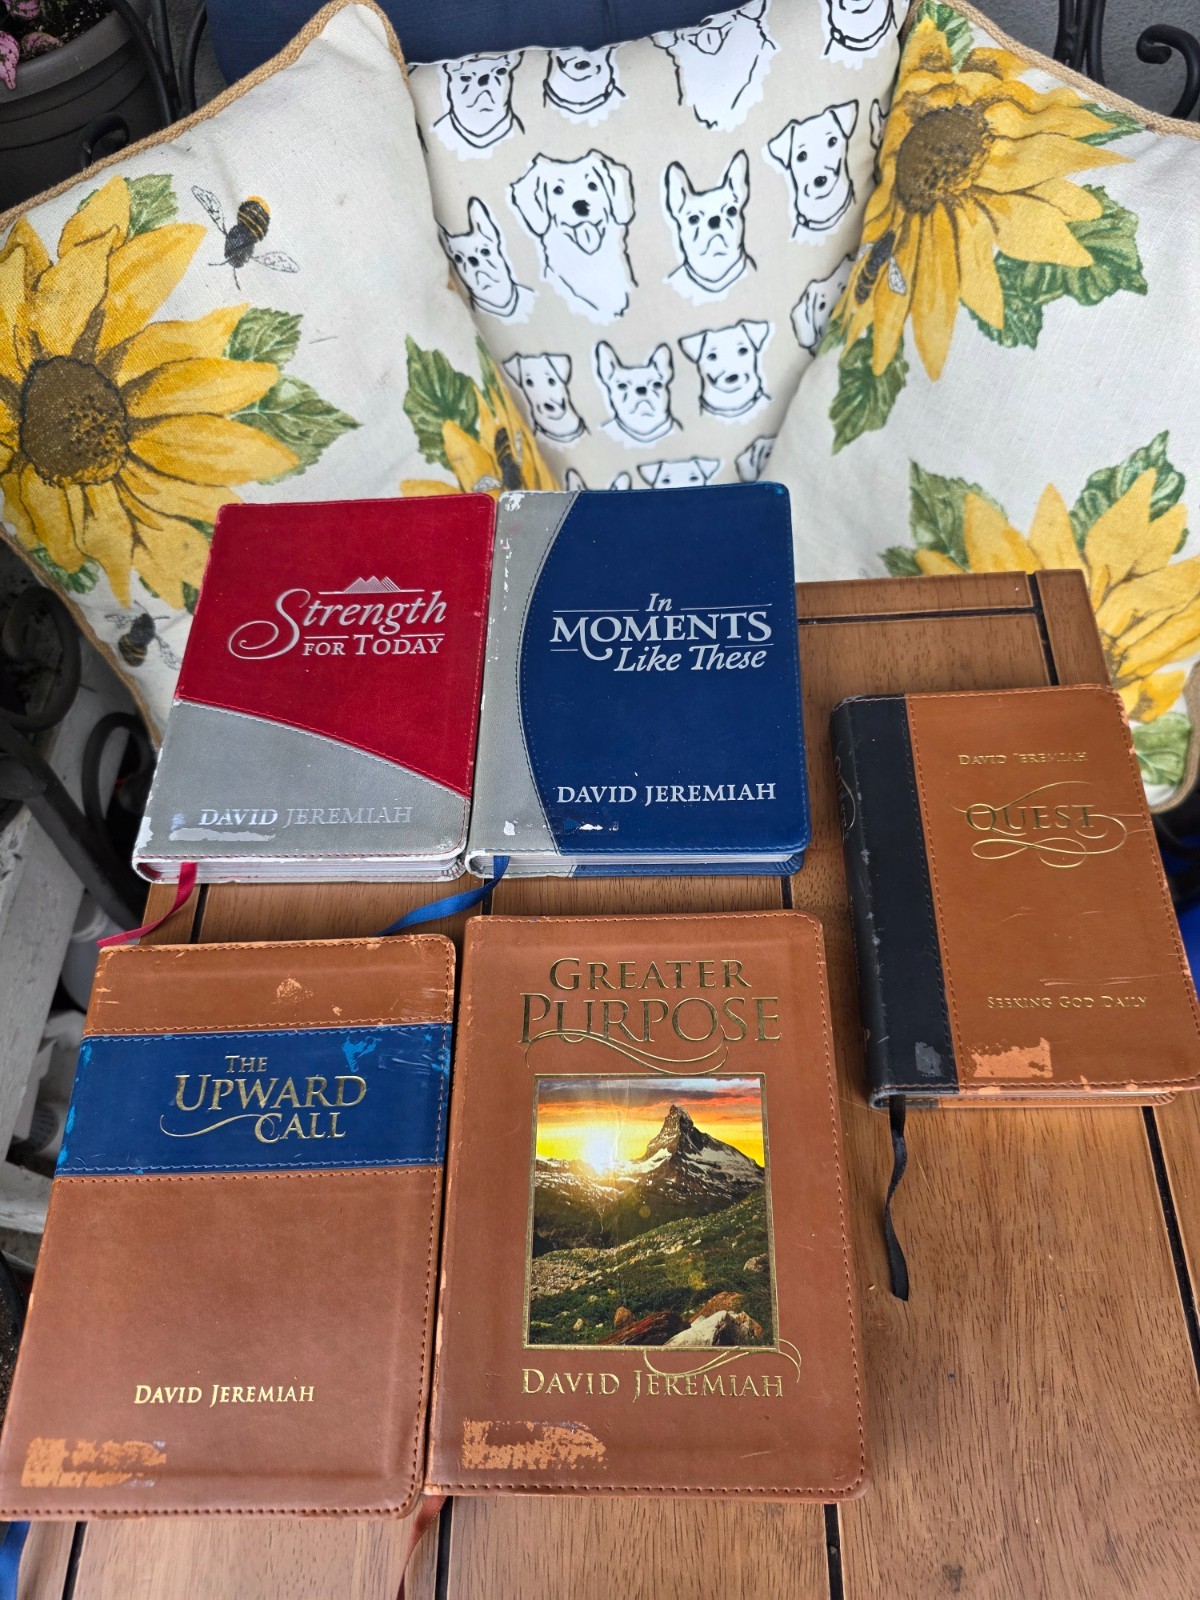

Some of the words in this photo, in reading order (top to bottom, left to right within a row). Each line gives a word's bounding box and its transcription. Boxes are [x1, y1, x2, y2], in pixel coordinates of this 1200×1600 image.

[645, 593, 673, 612] In
[229, 588, 447, 659] Strength
[549, 610, 772, 661] MOMENTS
[302, 641, 346, 656] FOR
[353, 634, 445, 656] TODAY
[613, 645, 682, 672] Like
[689, 643, 767, 671] These
[958, 753, 1007, 766] DAVID
[556, 785, 637, 804] DAVID
[644, 782, 777, 807] JEREMIAH
[199, 807, 278, 827] DAVID
[282, 805, 413, 829] JEREMIAH
[965, 803, 1096, 836] QUEST
[549, 957, 752, 991] GREATER
[986, 996, 1053, 1010] SEEKING
[1058, 995, 1094, 1010] GOD
[1100, 995, 1149, 1009] DAILY
[519, 993, 782, 1043] PURPOSE
[225, 1055, 268, 1073] THE
[175, 1074, 367, 1111] UPWARD
[254, 1112, 346, 1144] CALL
[134, 1384, 202, 1404] DAVID
[209, 1384, 314, 1406] JEREMIAH
[521, 1369, 620, 1394] DAVID
[633, 1369, 782, 1401] JEREMIAH
